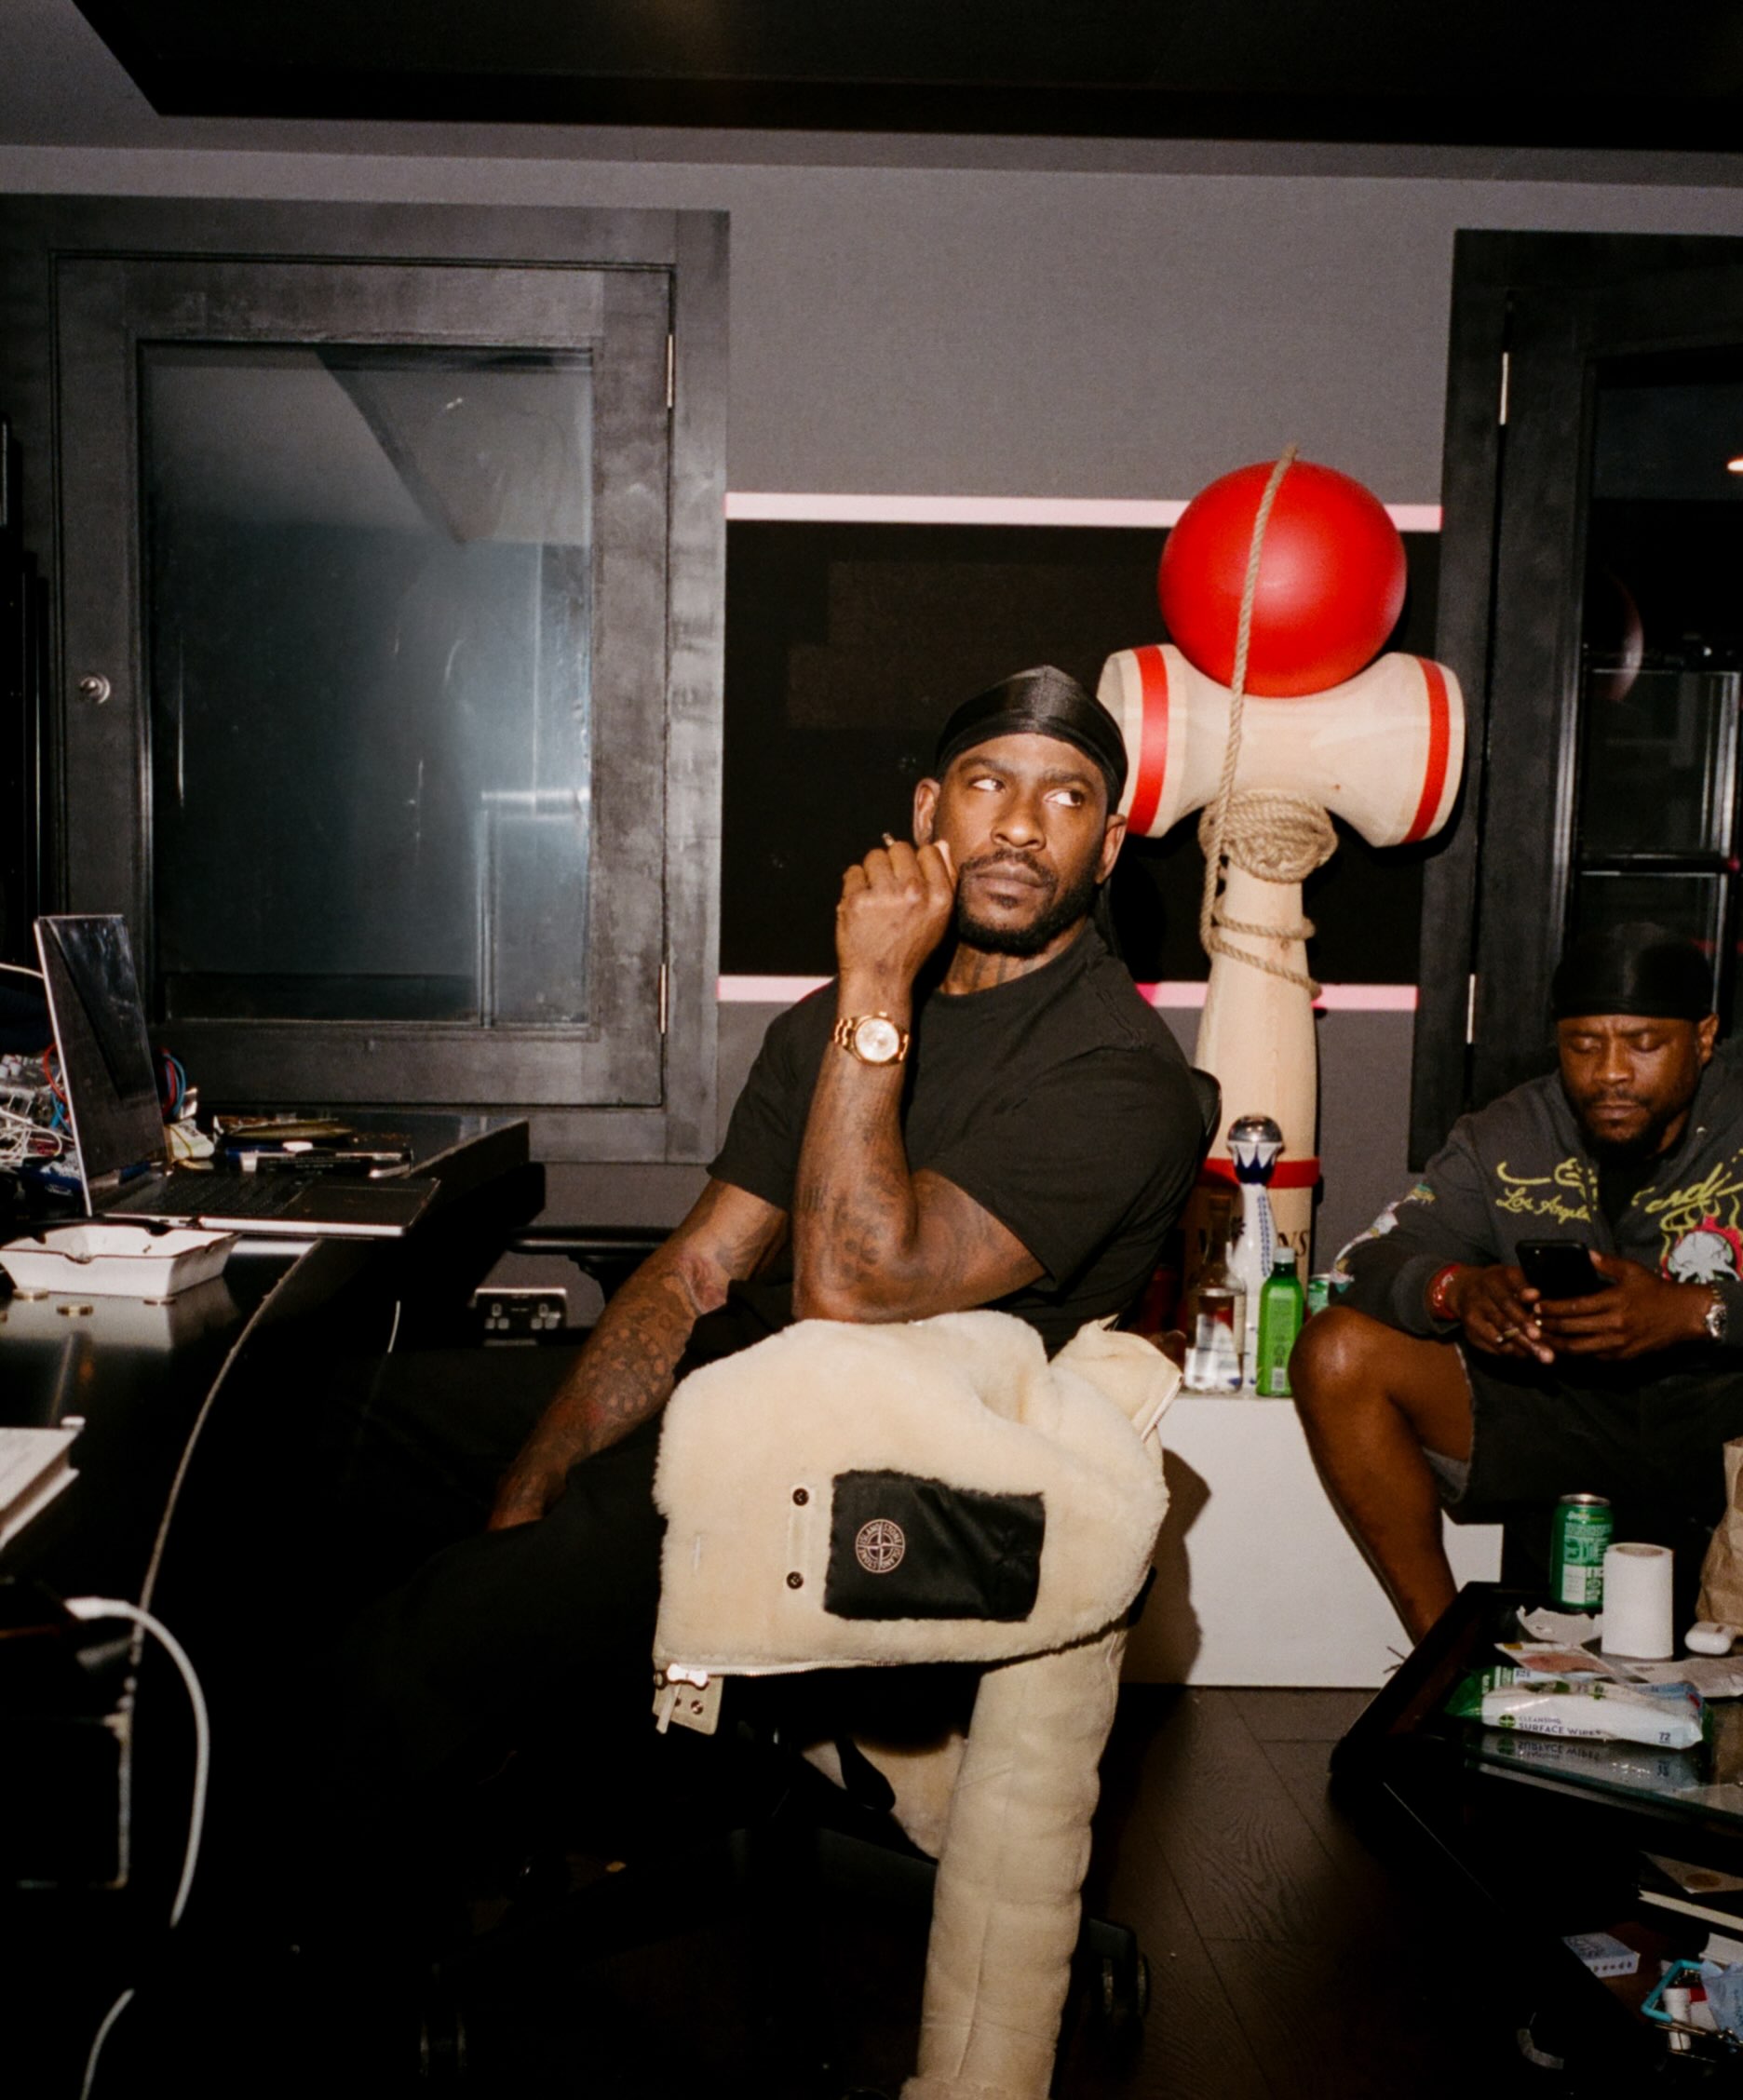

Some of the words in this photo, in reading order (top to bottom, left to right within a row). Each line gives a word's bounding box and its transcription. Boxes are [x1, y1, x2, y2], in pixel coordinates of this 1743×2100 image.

[1495, 1187, 1534, 1214] Los
[858, 1523, 880, 1545] ISLAND
[883, 1522, 902, 1545] STONE
[1519, 1722, 1564, 1734] SURFACE
[1658, 1731, 1671, 1741] 72
